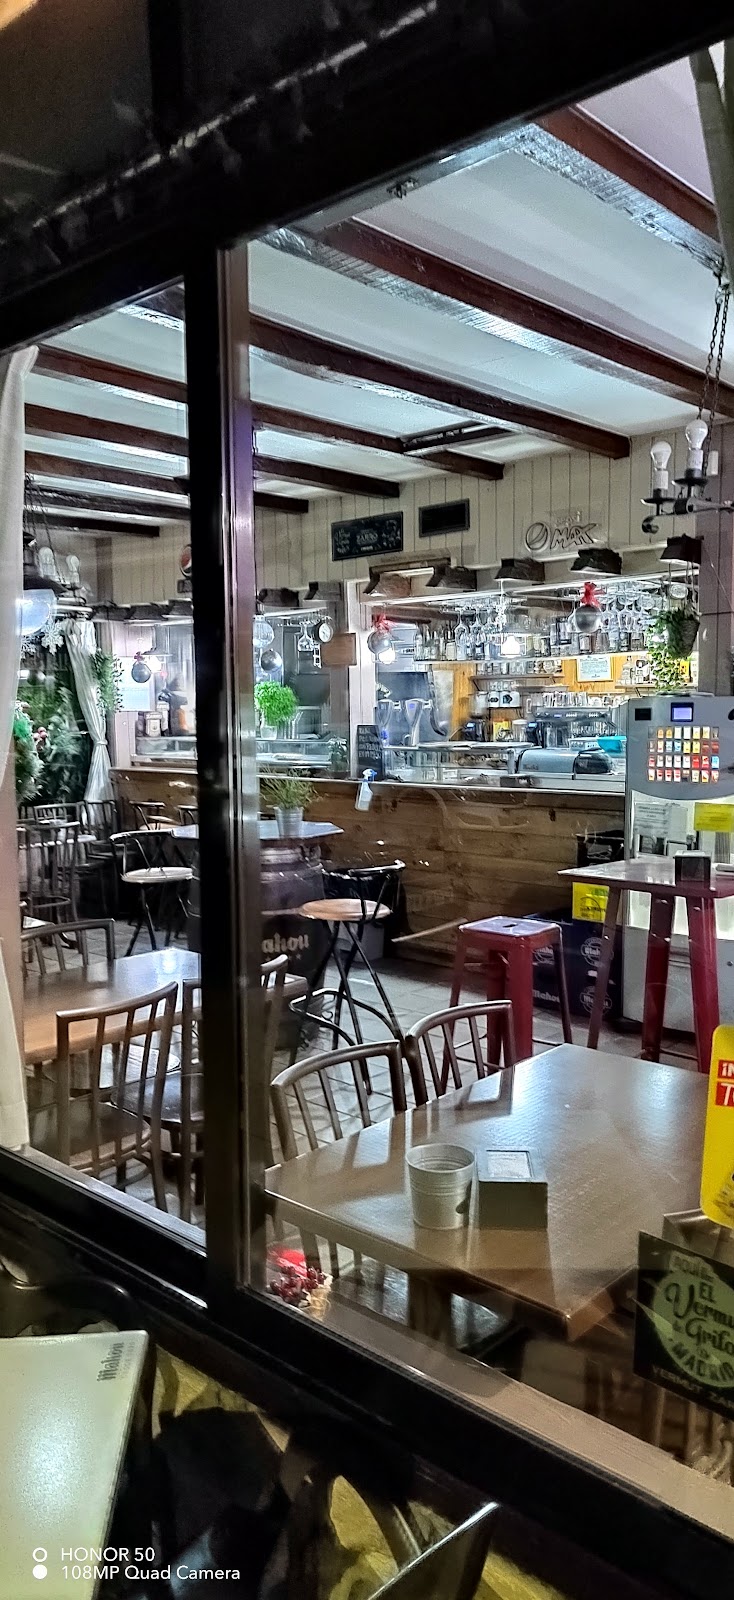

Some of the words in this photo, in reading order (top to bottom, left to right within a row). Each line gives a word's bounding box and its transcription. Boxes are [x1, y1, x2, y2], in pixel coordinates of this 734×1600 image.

[550, 523, 597, 549] MAX
[262, 932, 310, 954] ahou
[685, 1317, 734, 1357] Grifo
[96, 1342, 125, 1382] Mahou
